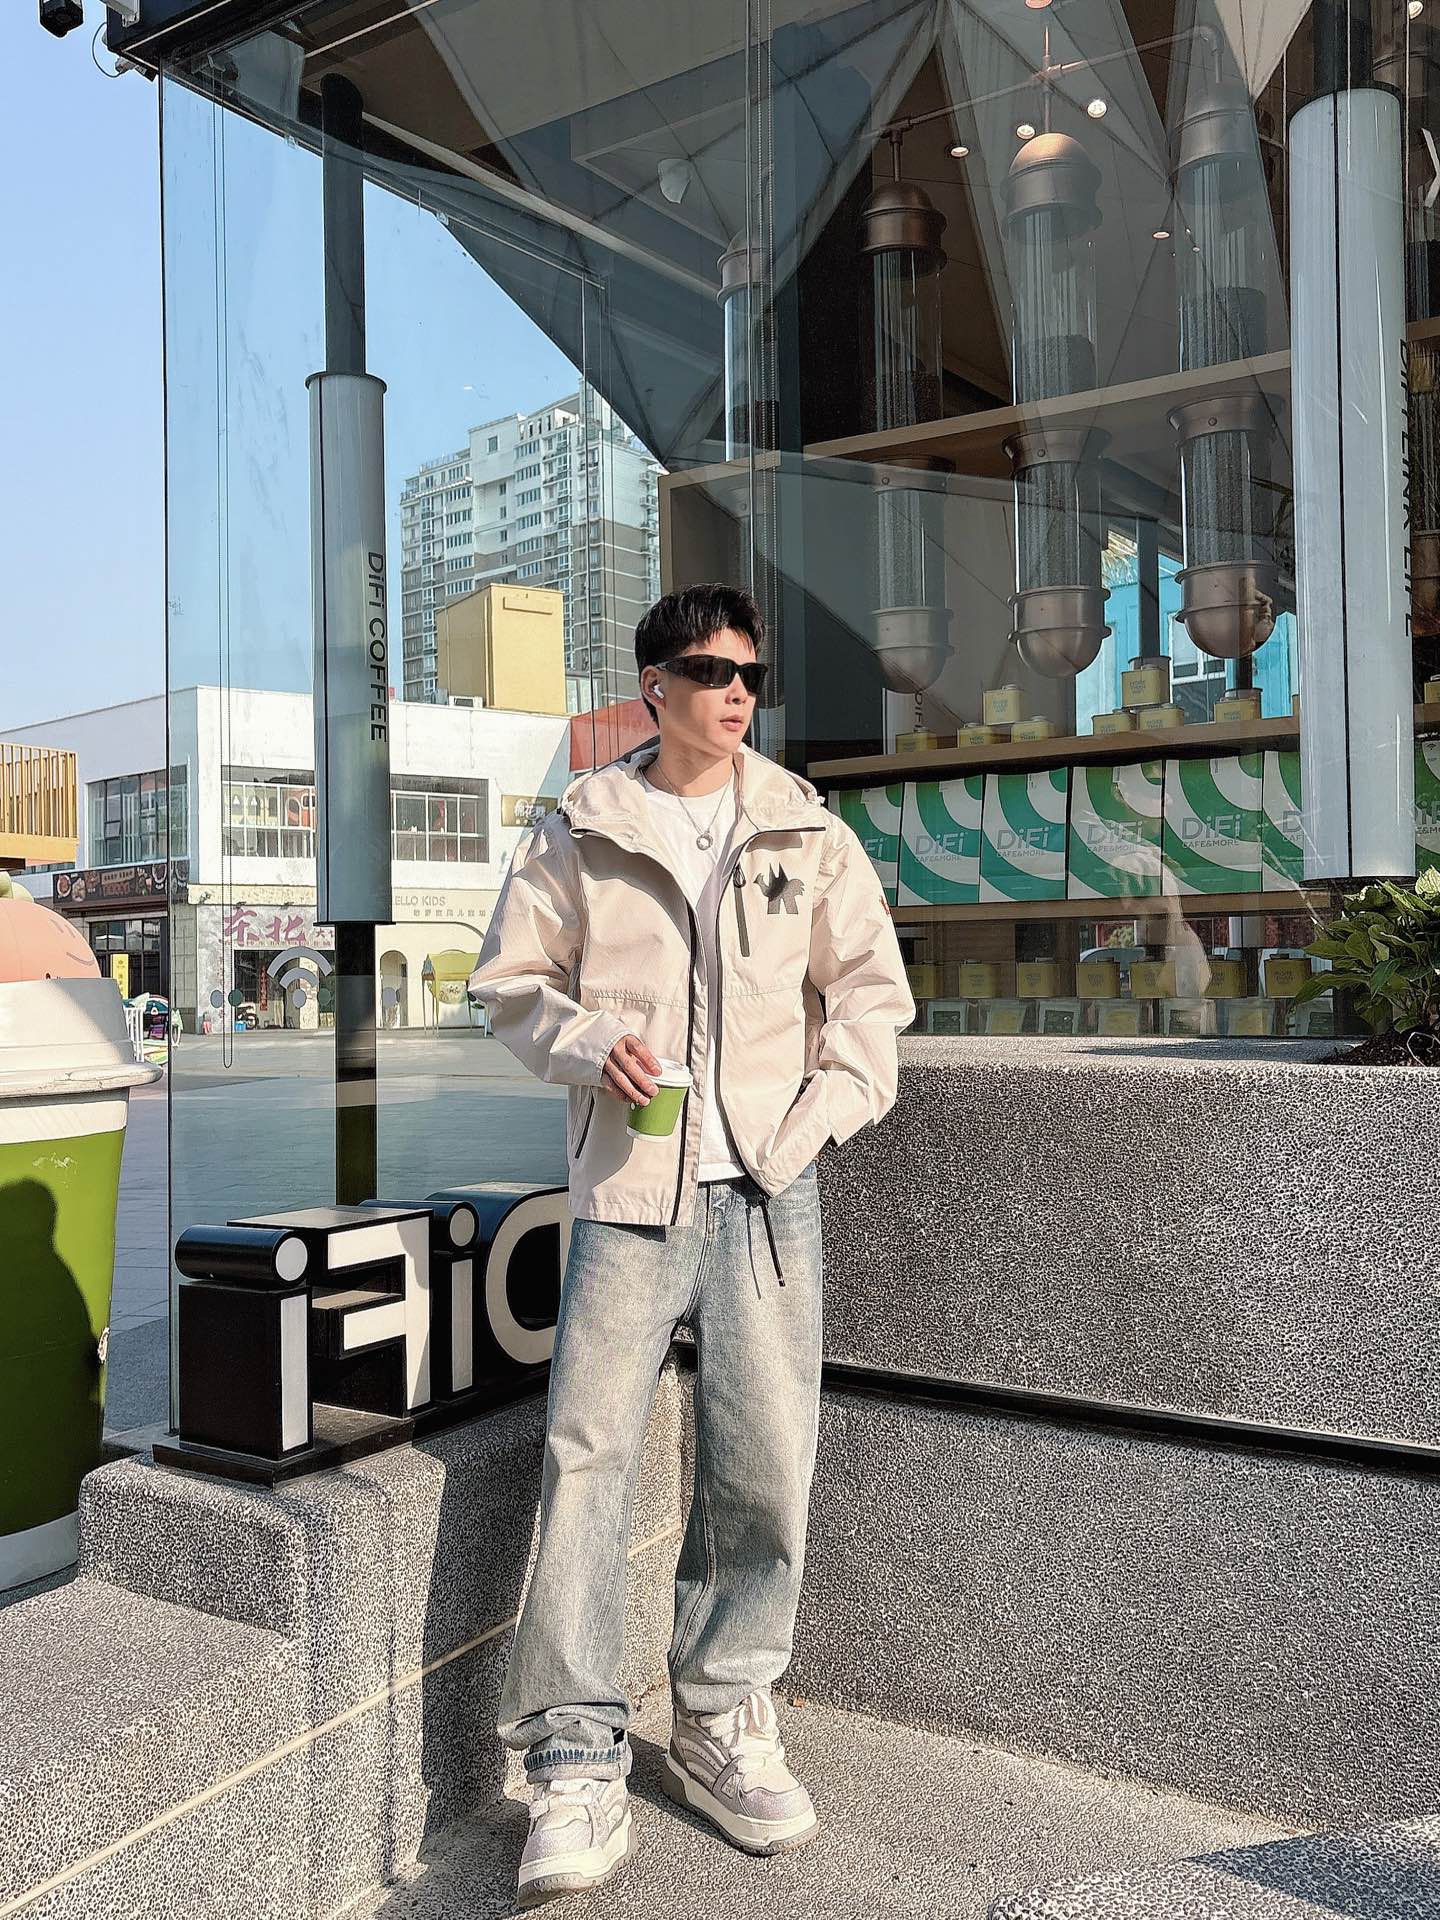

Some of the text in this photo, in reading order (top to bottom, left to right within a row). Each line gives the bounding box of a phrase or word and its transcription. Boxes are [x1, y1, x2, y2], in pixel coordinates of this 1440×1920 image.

[369, 617, 388, 743] COFFEE
[1086, 820, 1143, 845] DiFi
[1181, 813, 1241, 840] DiFi
[914, 832, 966, 856] DiFi
[996, 827, 1050, 851] DiFi
[1182, 838, 1240, 849] CAFE&MORE
[394, 896, 447, 907] ELLO KIDS
